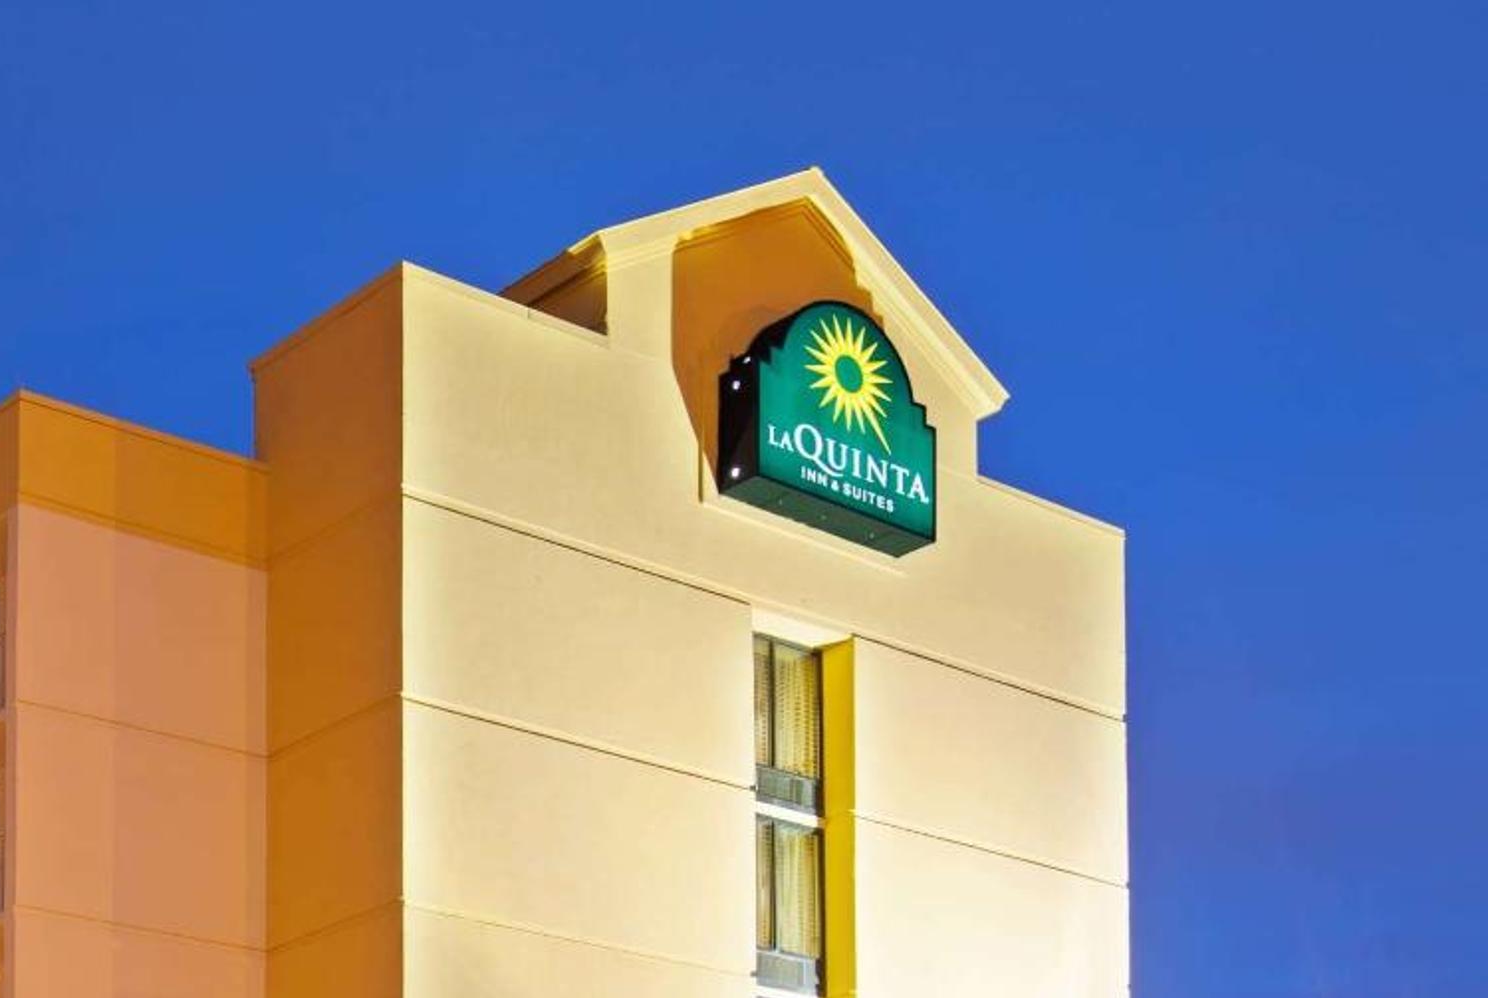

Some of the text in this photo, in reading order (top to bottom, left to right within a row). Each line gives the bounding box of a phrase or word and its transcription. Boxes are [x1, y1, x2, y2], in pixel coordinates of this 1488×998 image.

[793, 423, 930, 504] QUINTA
[801, 466, 895, 512] INN & SUITES
